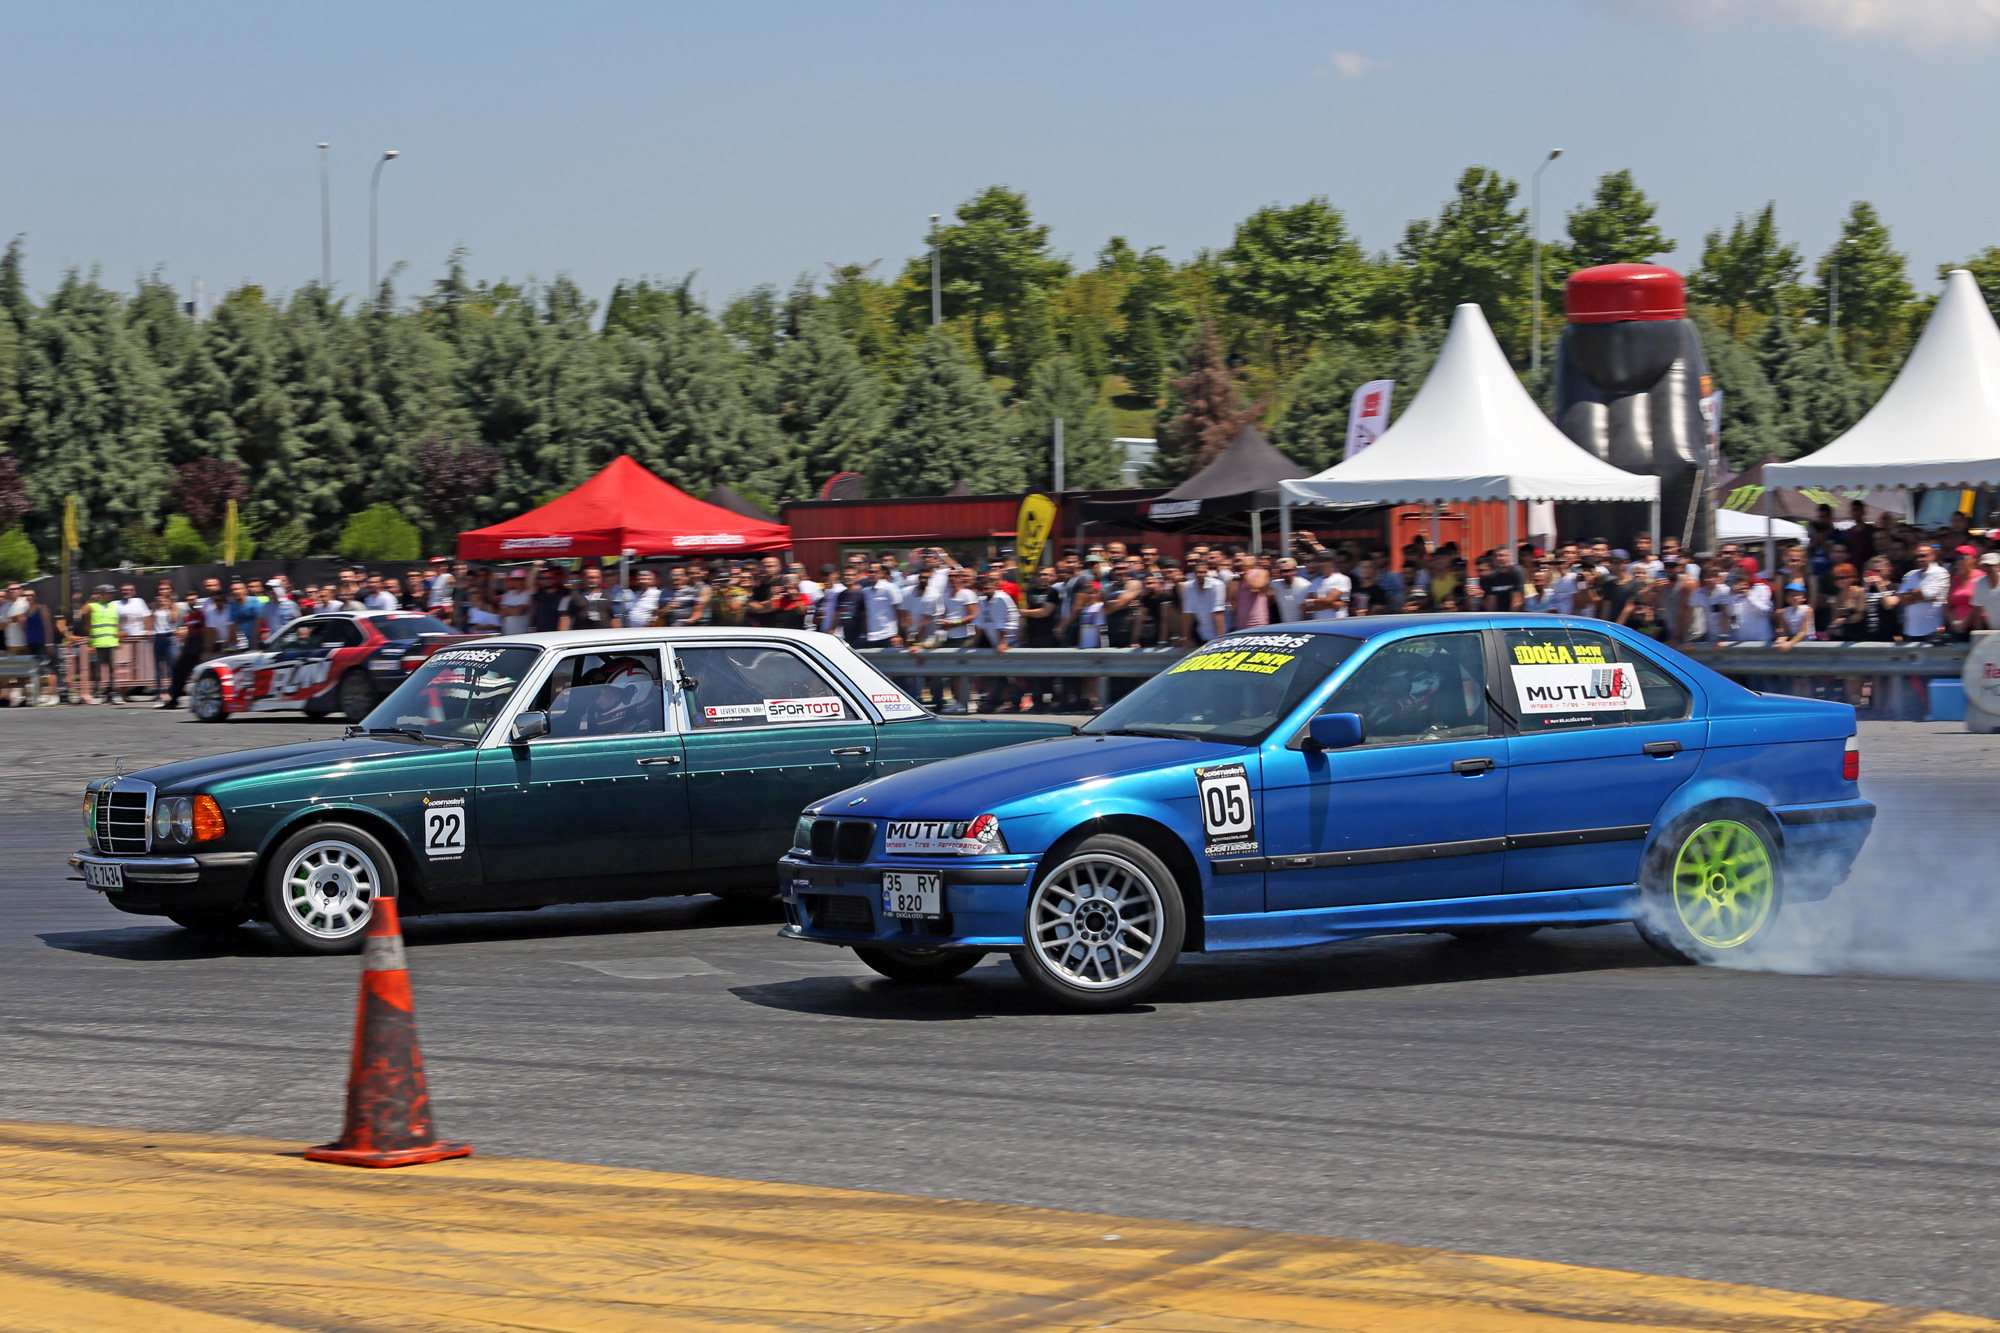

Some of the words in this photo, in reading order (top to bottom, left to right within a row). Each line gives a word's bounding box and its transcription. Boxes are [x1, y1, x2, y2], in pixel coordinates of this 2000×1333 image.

[1247, 652, 1295, 666] BMW
[1520, 642, 1574, 664] DOĞA
[1573, 646, 1601, 656] BMW
[873, 695, 899, 703] MOTUL
[1526, 685, 1612, 701] MUTLU
[720, 707, 736, 715] LEVENT
[884, 703, 912, 711] sparco
[1204, 766, 1245, 777] apexmasters
[1207, 784, 1245, 827] 05
[430, 814, 460, 848] 22
[886, 823, 968, 839] MUTLU
[937, 841, 982, 850] Performance
[1205, 841, 1259, 853] apexmasters
[100, 867, 120, 885] 7434
[886, 874, 902, 891] 35
[917, 875, 938, 893] RY
[898, 894, 922, 911] 820
